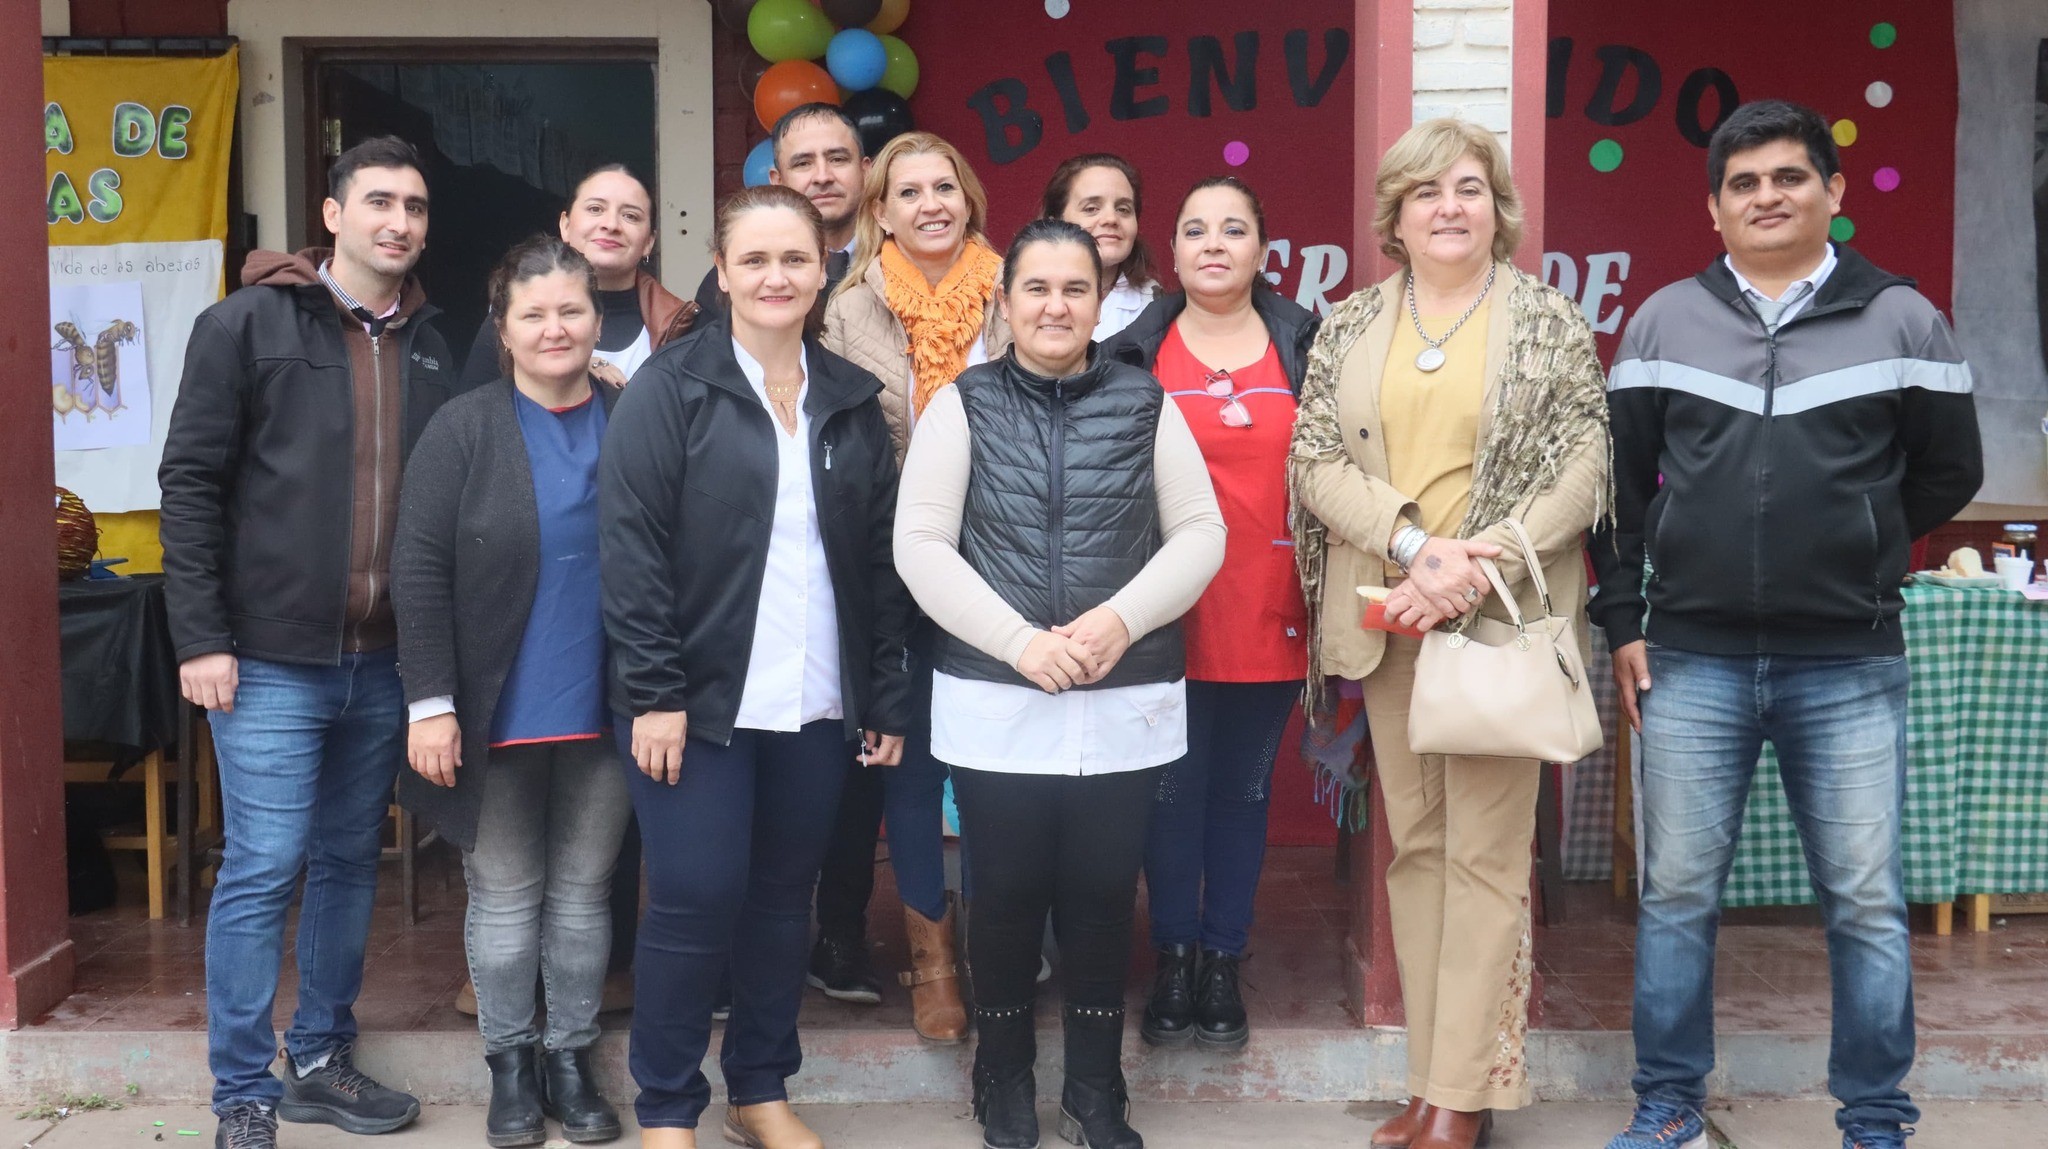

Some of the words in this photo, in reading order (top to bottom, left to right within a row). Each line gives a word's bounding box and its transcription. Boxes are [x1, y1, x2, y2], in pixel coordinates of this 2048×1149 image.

[112, 102, 192, 160] DE
[90, 255, 108, 276] de
[1541, 251, 1631, 334] DE
